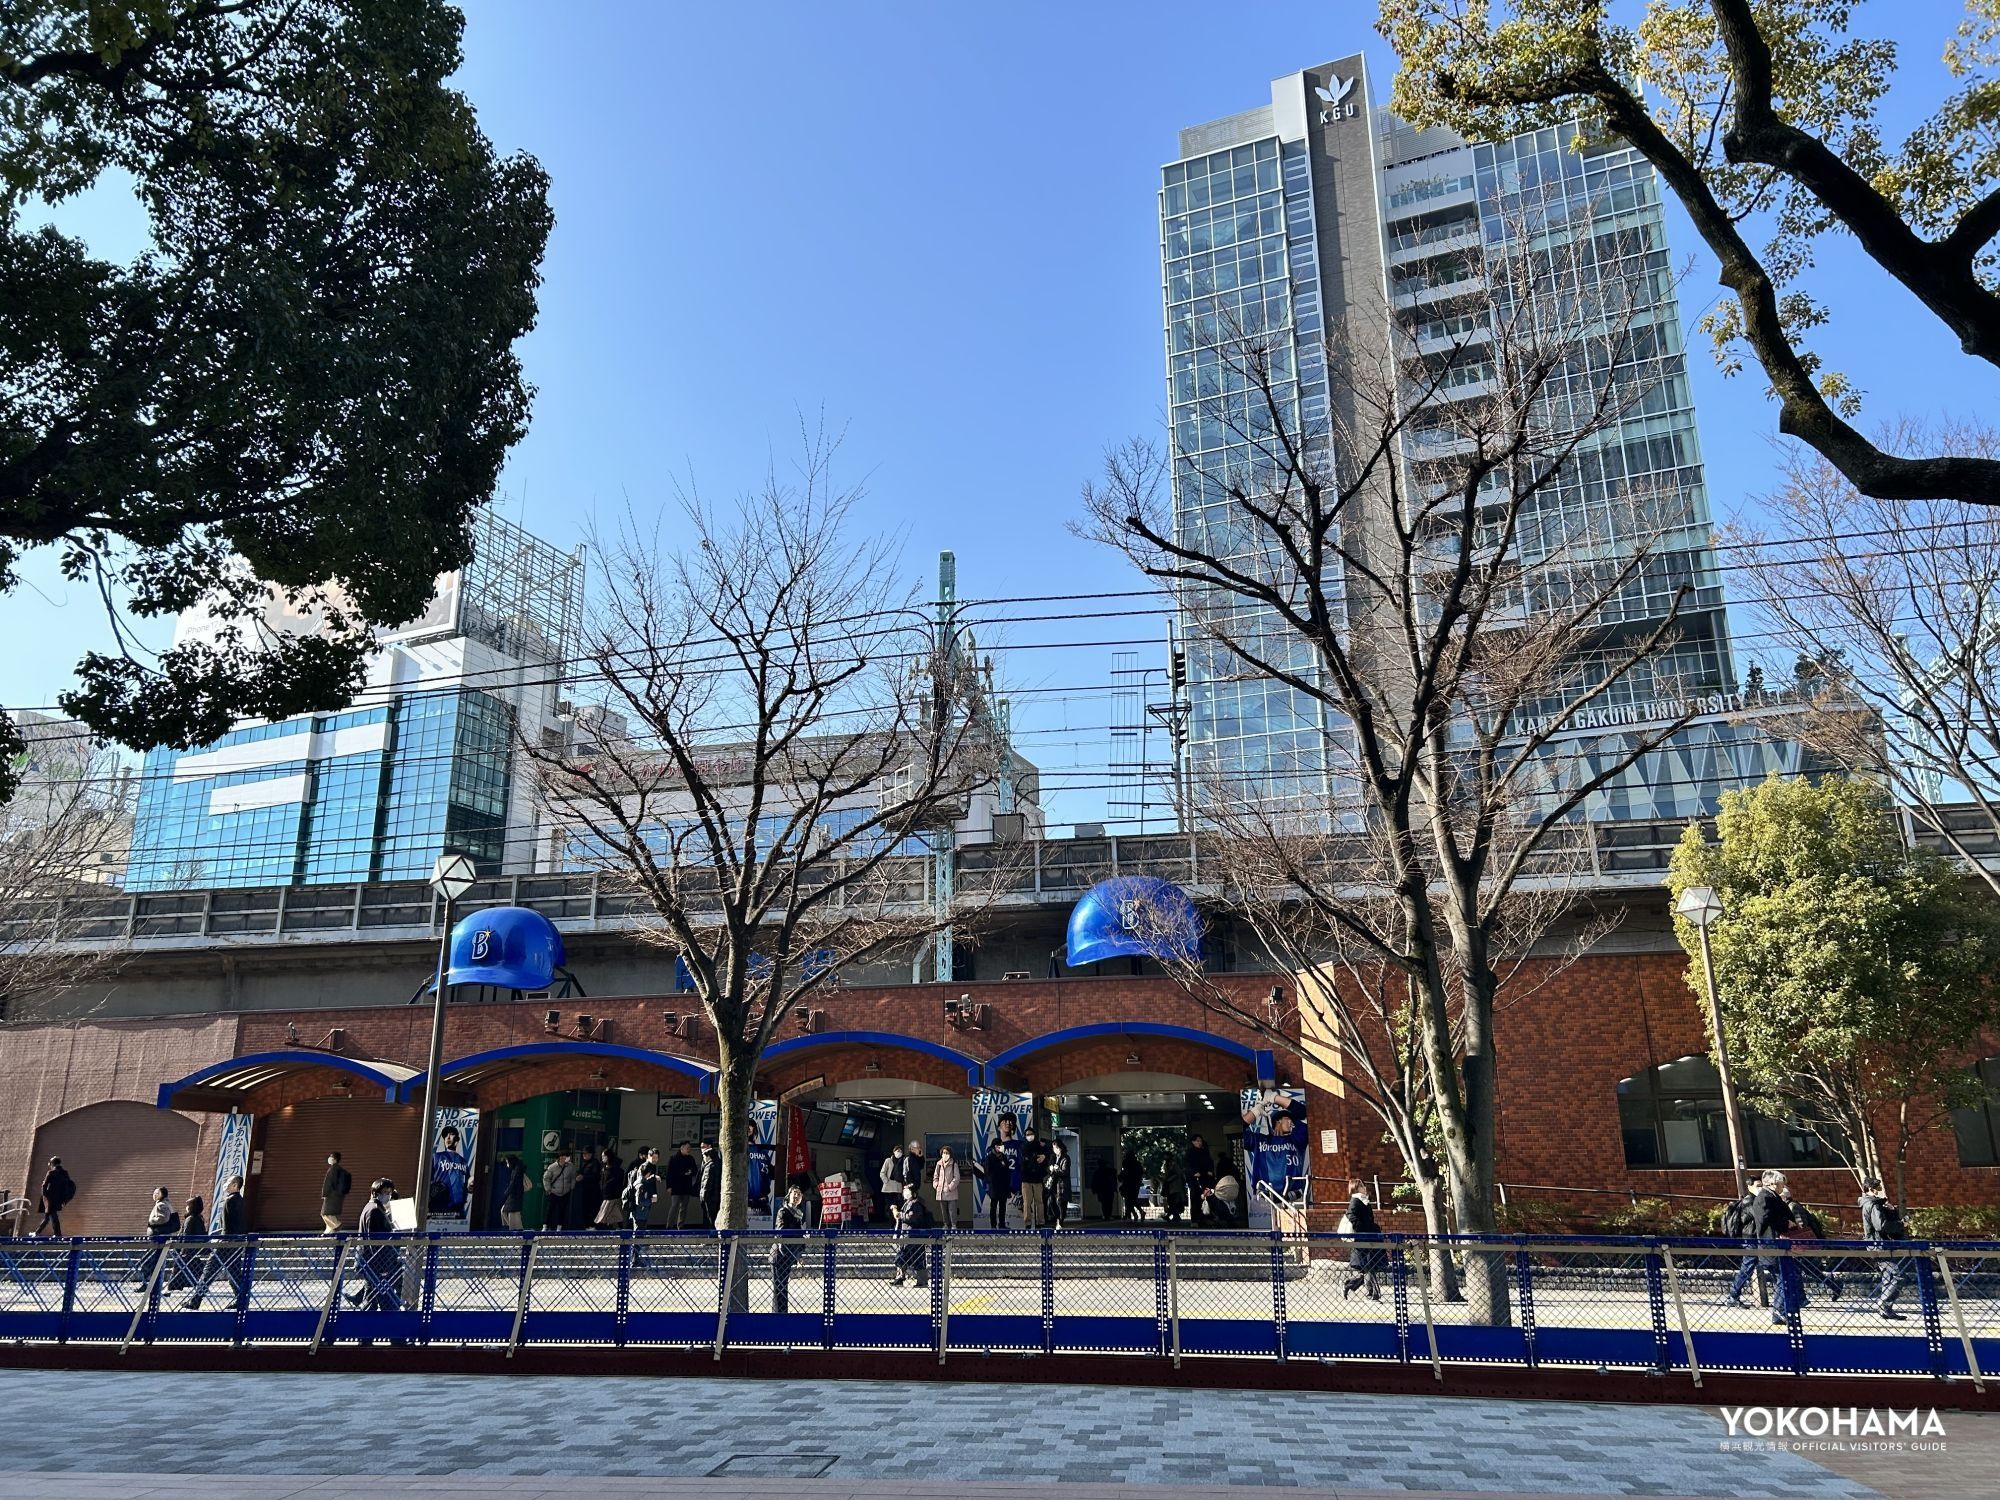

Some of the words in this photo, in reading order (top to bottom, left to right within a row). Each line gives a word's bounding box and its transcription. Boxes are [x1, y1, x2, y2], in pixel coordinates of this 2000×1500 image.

[1319, 103, 1354, 124] KGU
[1514, 714, 1569, 736] KAN
[1574, 704, 1640, 729] GAKUIN
[972, 1092, 1010, 1105] SEND
[973, 1105, 992, 1114] THE
[994, 1105, 1033, 1114] POWER
[1241, 1101, 1256, 1110] TH
[435, 1108, 460, 1120] END
[748, 1111, 777, 1120] OWER
[445, 1119, 479, 1128] POWER
[230, 1127, 245, 1176] あなたの力
[1259, 1141, 1297, 1153] YOKOHAMA
[1008, 1158, 1016, 1170] 2
[1285, 1155, 1299, 1167] 50
